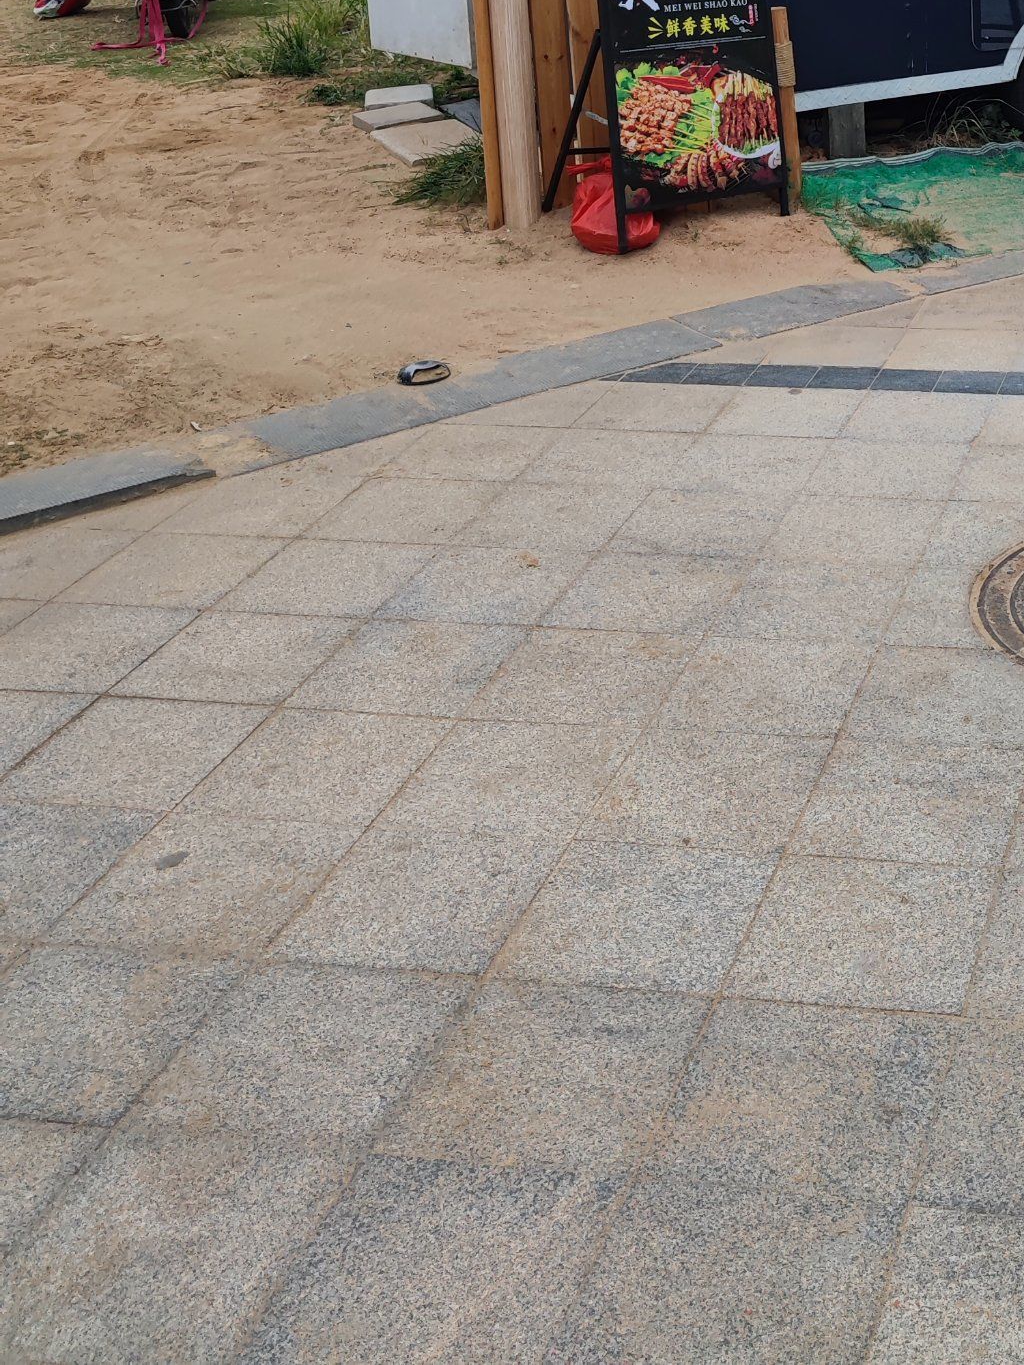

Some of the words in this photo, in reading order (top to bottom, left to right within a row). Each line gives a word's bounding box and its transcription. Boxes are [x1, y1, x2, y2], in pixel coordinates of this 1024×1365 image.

[664, 4, 682, 13] MEI
[684, 2, 702, 11] WEI
[704, 0, 728, 10] SHAO
[665, 14, 731, 38] 鲜香美味
